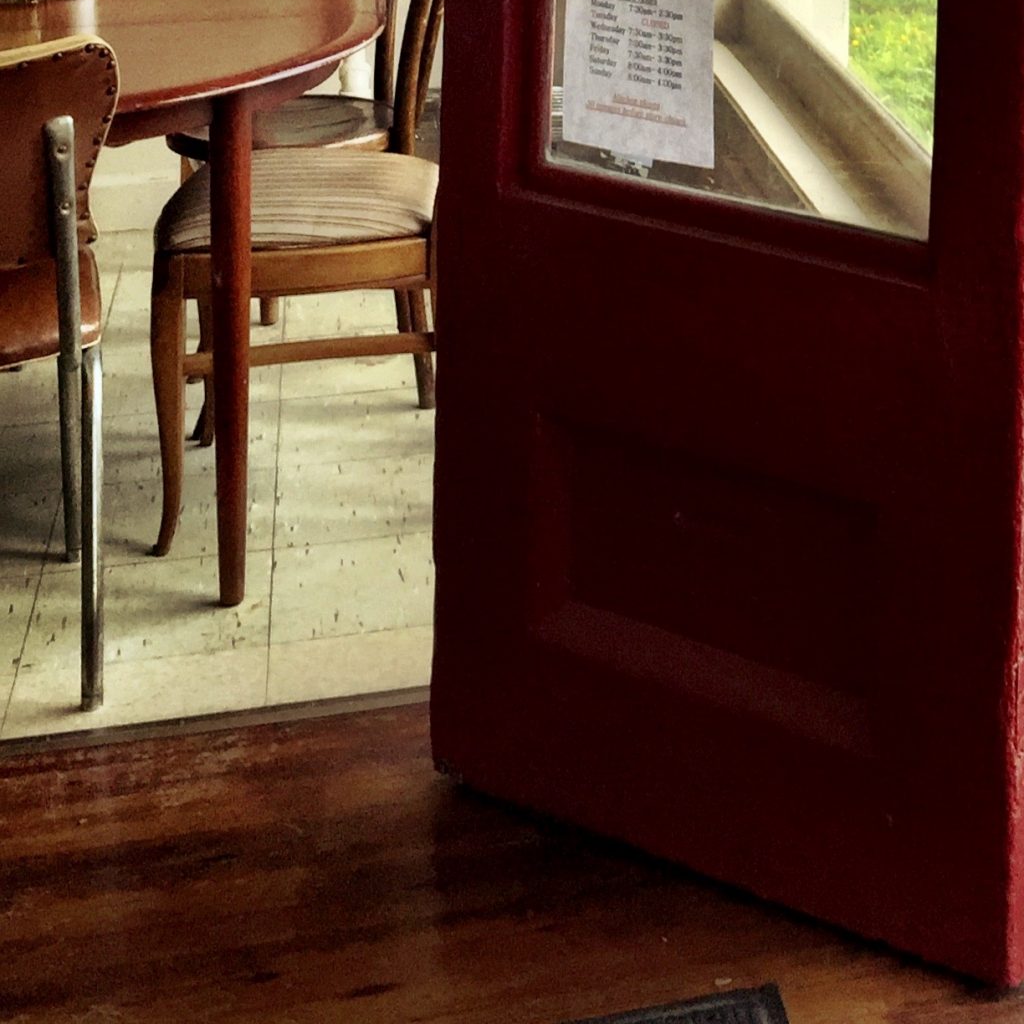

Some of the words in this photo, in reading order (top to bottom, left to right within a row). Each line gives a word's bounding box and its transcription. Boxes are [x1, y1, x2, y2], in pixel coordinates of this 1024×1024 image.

[590, 9, 618, 22] Tuesday
[641, 18, 669, 31] CLOSED
[589, 20, 626, 36] Wednesday
[591, 32, 620, 45] Thursday
[589, 43, 610, 55] Friday
[589, 55, 617, 68] Saturday
[589, 66, 613, 78] Sunday
